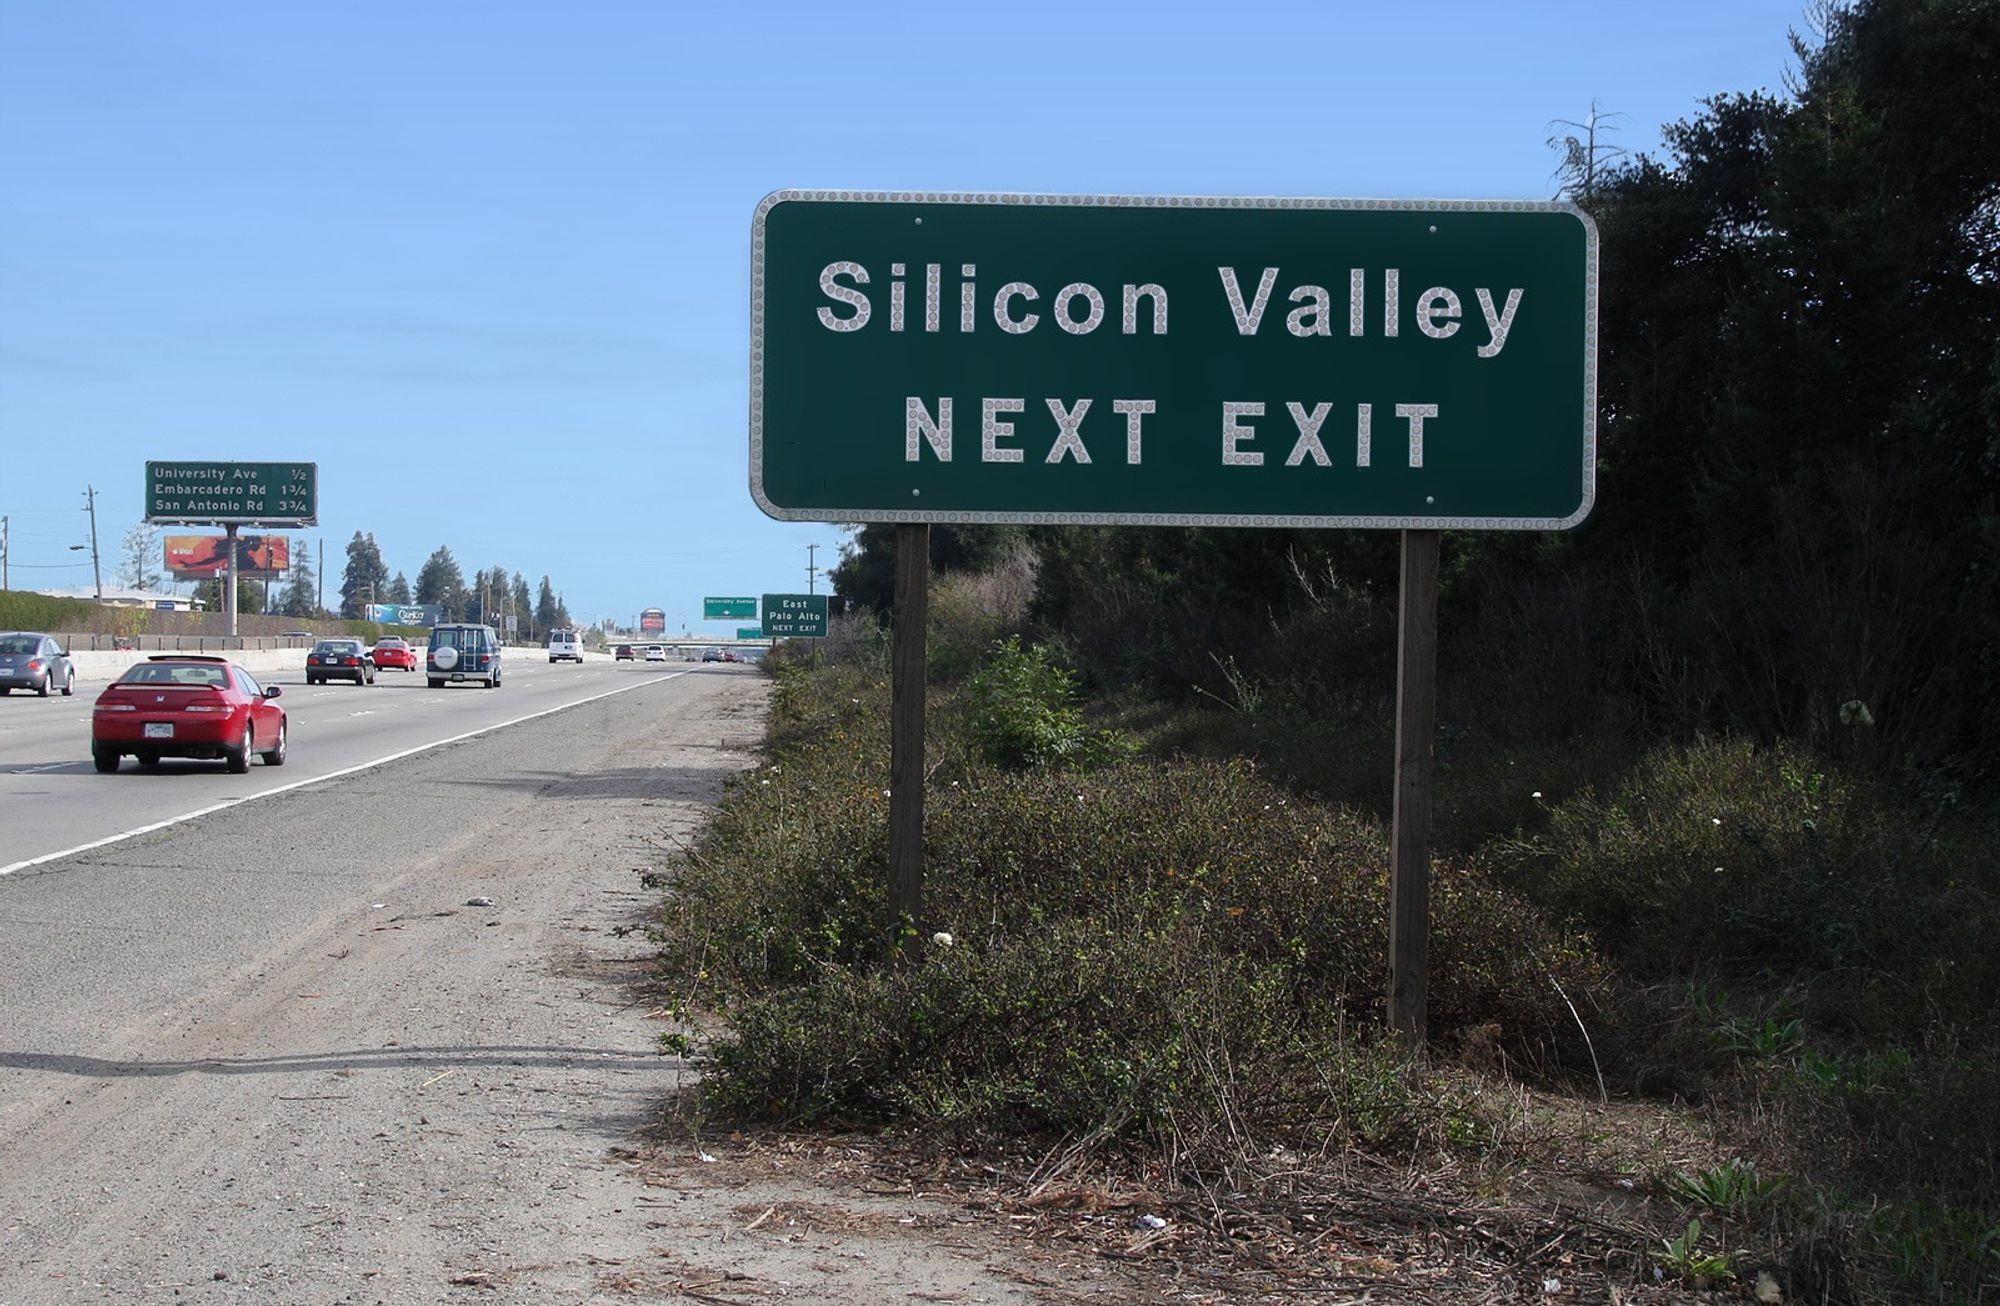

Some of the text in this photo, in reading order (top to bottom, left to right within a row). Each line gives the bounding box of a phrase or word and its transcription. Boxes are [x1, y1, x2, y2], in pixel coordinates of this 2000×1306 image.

[816, 260, 1525, 358] Silicon Valley
[905, 396, 1439, 468] NEXT EXIT
[155, 468, 226, 481] University
[233, 468, 258, 479] Ave
[155, 484, 243, 495] Embarcadero
[249, 484, 266, 495] Rd
[155, 500, 180, 511] San
[187, 500, 240, 511] Antonio
[246, 500, 264, 511] Rd
[782, 599, 808, 608] East
[769, 611, 821, 621] Palo Alto
[772, 624, 817, 632] NEXT EXIT
